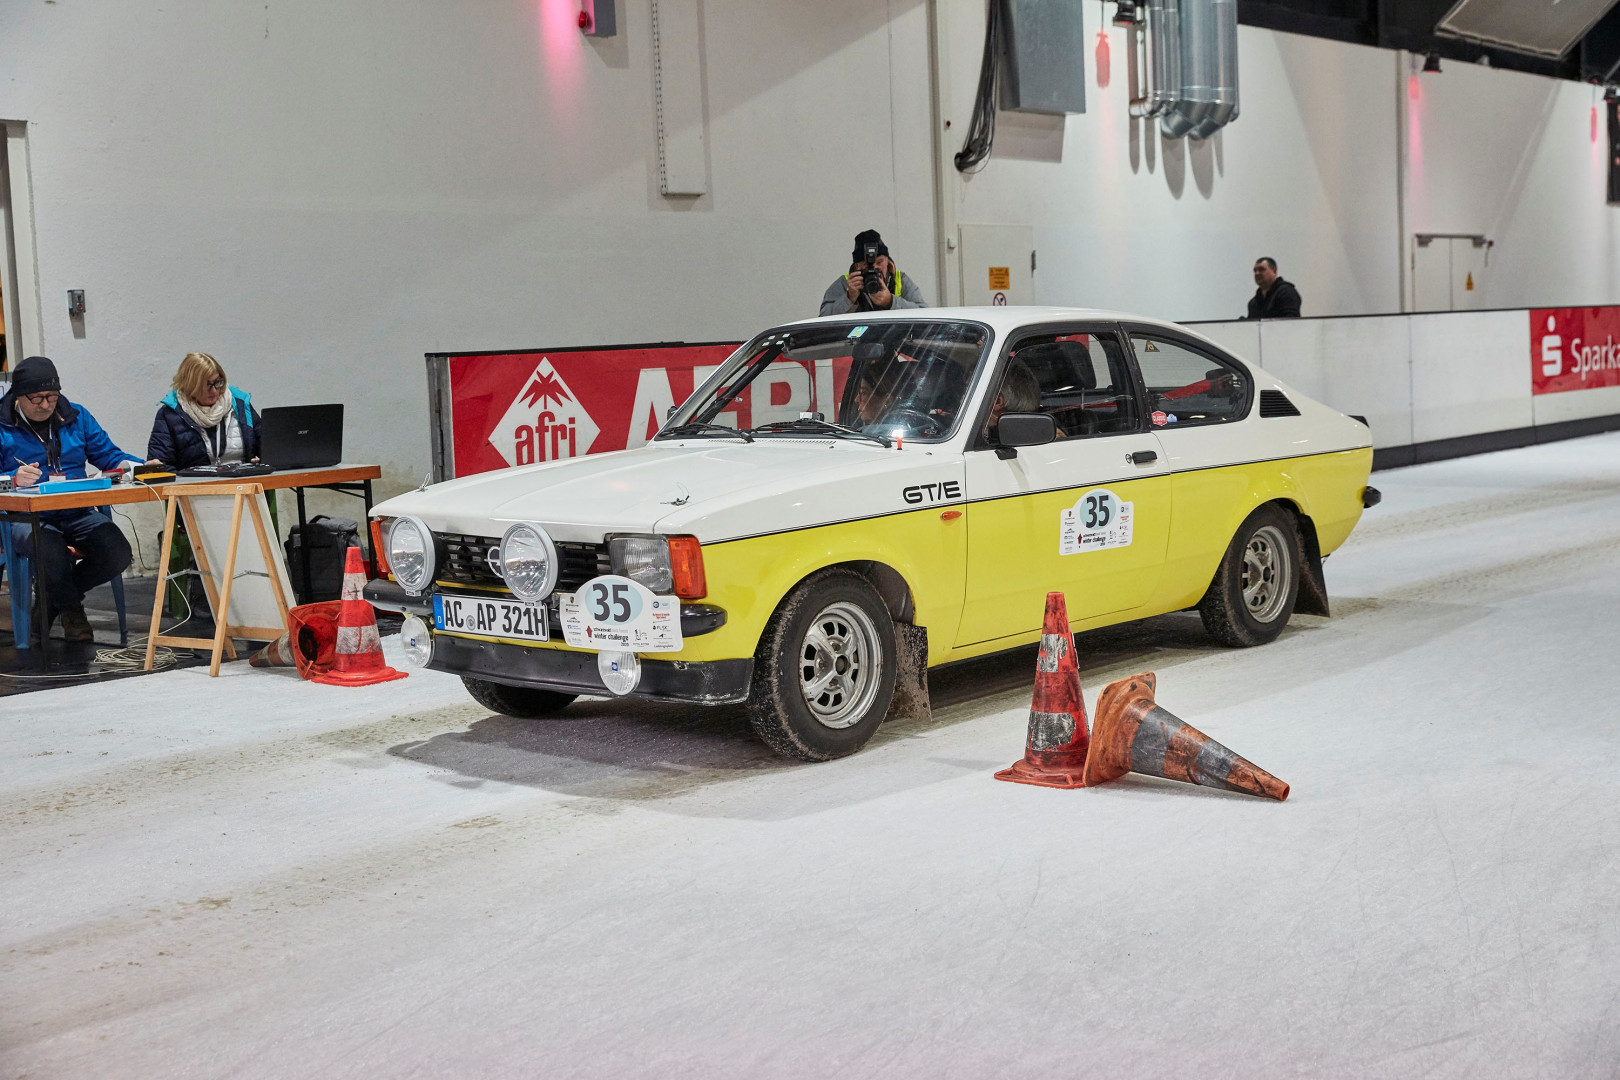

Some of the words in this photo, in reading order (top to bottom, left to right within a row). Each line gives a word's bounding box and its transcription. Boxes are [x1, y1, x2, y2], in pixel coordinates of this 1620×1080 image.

[515, 411, 576, 466] afri
[1086, 495, 1110, 528] 35
[445, 600, 464, 628] AC
[477, 603, 497, 631] AP
[501, 605, 546, 636] 321H
[592, 583, 631, 622] 35
